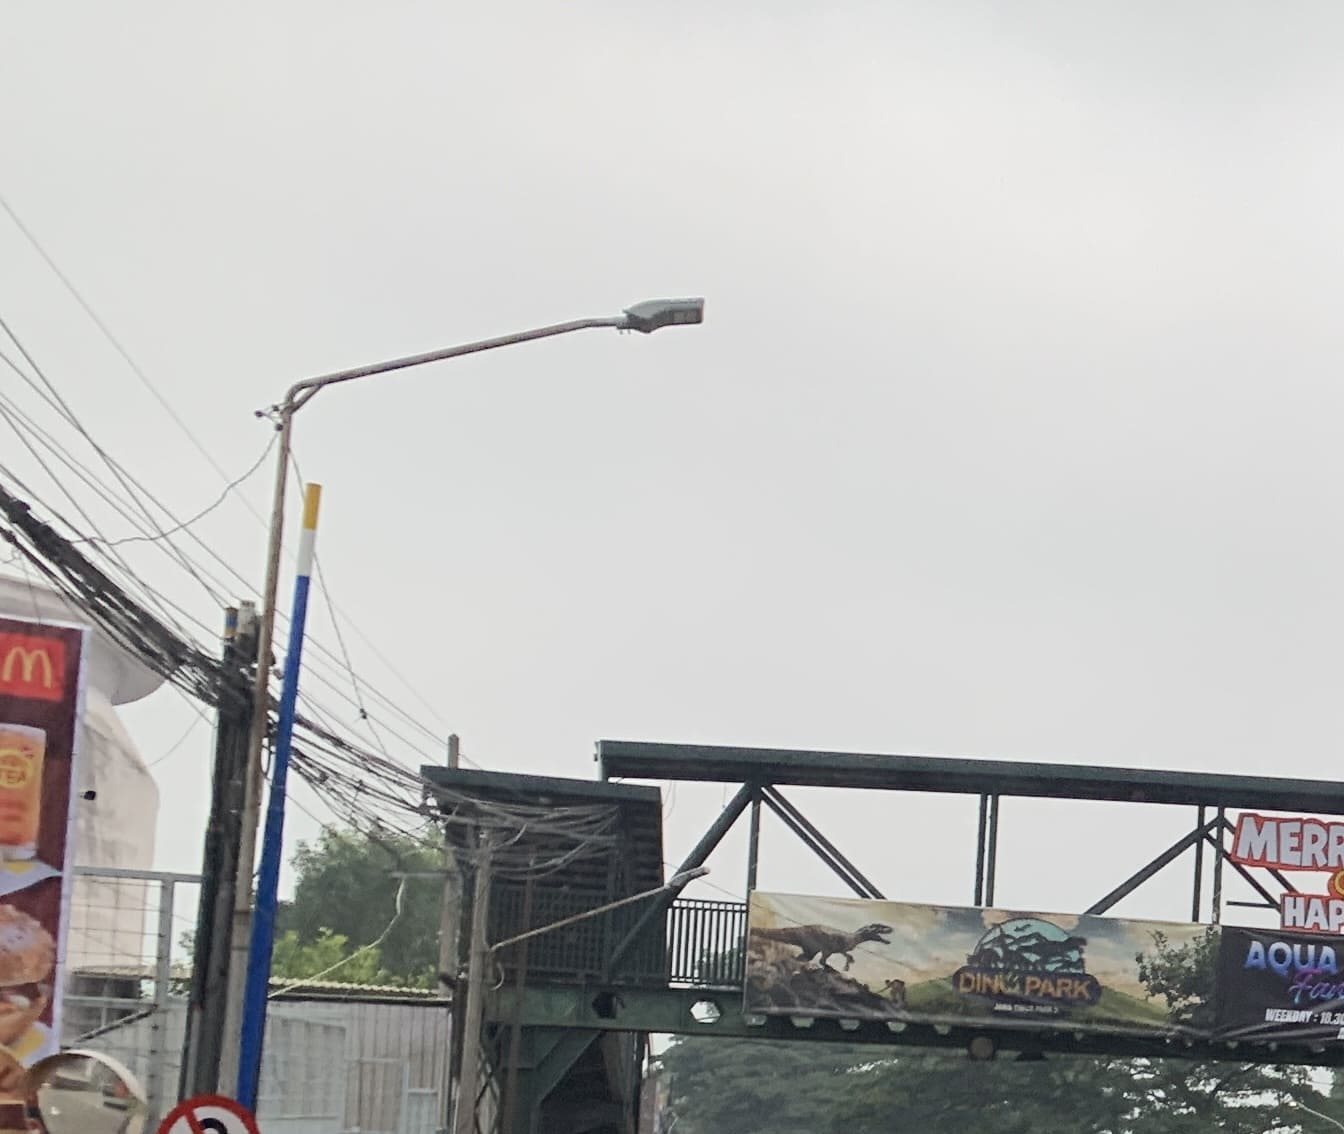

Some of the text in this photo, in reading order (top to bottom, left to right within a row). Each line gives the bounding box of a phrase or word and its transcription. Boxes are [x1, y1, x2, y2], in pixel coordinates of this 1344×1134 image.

[1244, 940, 1338, 977] AQUA
[959, 972, 1090, 999] DINO PARK
[1265, 1008, 1313, 1022] WEEKDAY
